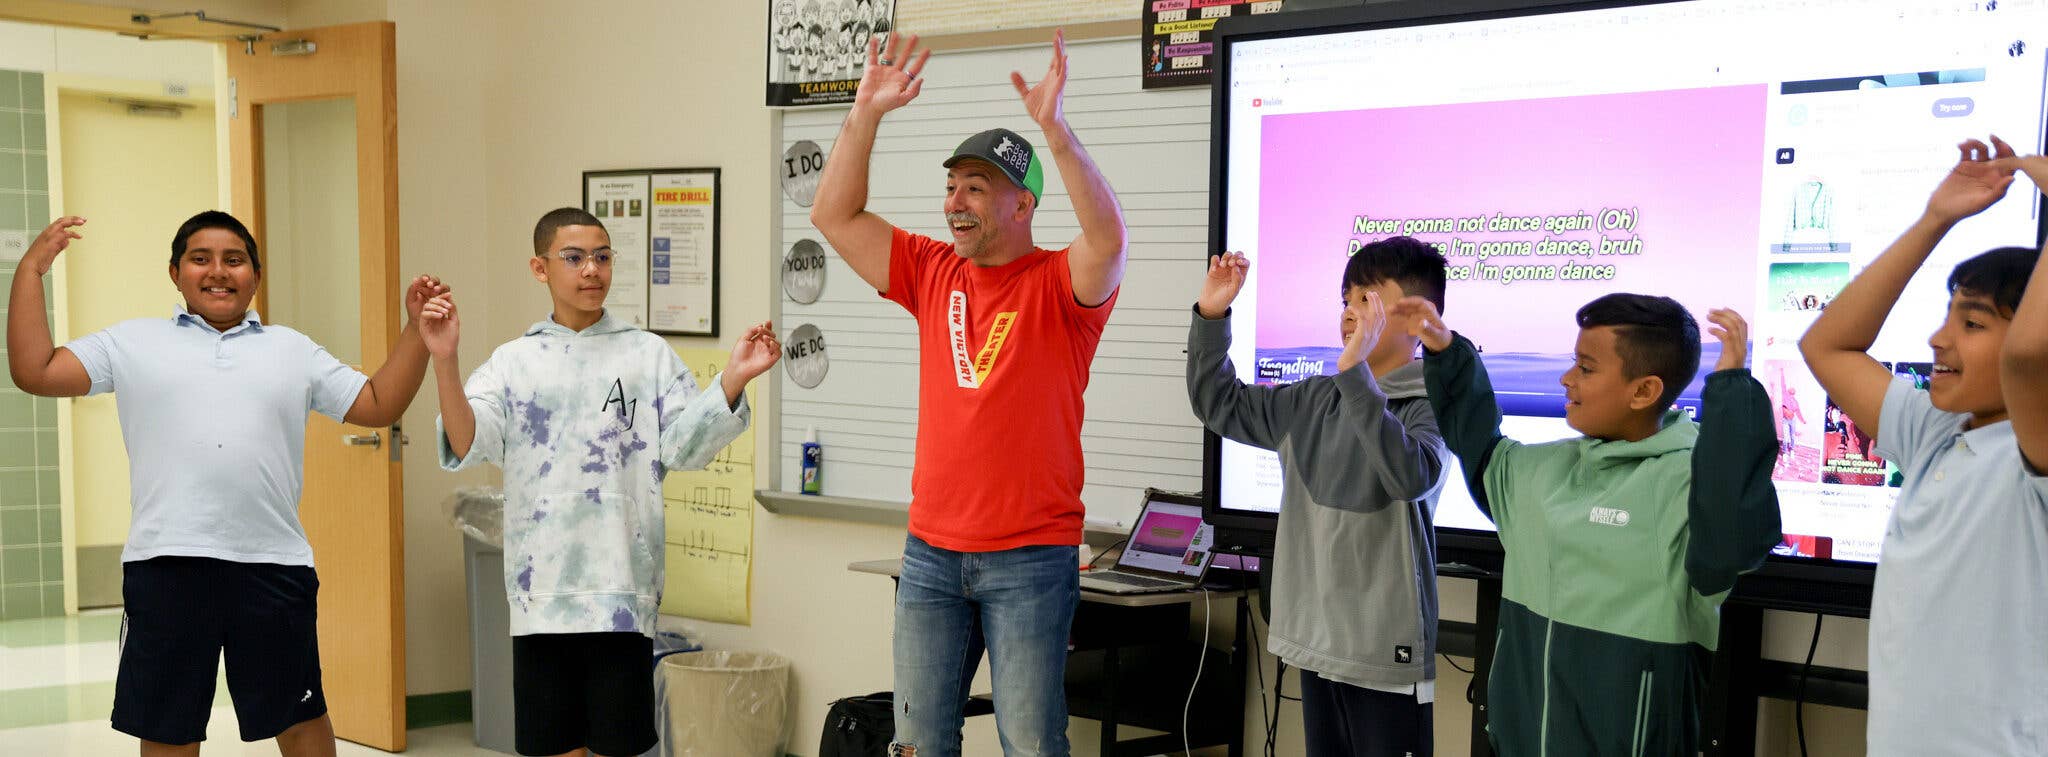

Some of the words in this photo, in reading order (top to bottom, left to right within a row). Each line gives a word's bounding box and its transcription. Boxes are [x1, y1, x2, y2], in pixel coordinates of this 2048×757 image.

[1939, 103, 1952, 113] Try
[785, 157, 798, 178] I
[800, 151, 823, 175] DO
[1003, 147, 1027, 173] Seed
[1012, 143, 1029, 161] Bad
[1780, 151, 1790, 160] All
[656, 191, 678, 202] FIRE
[680, 191, 710, 202] DRILL
[1353, 216, 1402, 234] Never
[1402, 219, 1454, 237] gonna
[1457, 214, 1486, 232] not
[1488, 211, 1541, 232] dance
[1544, 210, 1593, 235] again
[1596, 207, 1639, 233] (Oh)
[1450, 238, 1476, 256] I'm
[1478, 241, 1532, 260] gonna
[1535, 236, 1595, 259] dance,
[1599, 234, 1643, 256] bruh
[787, 257, 809, 272] YOU
[811, 254, 825, 270] DO
[1473, 261, 1500, 280] I'm
[1500, 264, 1556, 285] gonna
[1559, 259, 1616, 280] dance
[952, 295, 962, 327] NEW
[786, 342, 807, 361] WE
[955, 330, 973, 383] VICTORY
[976, 316, 1010, 374] THEATER
[1851, 460, 1879, 468] GONNA
